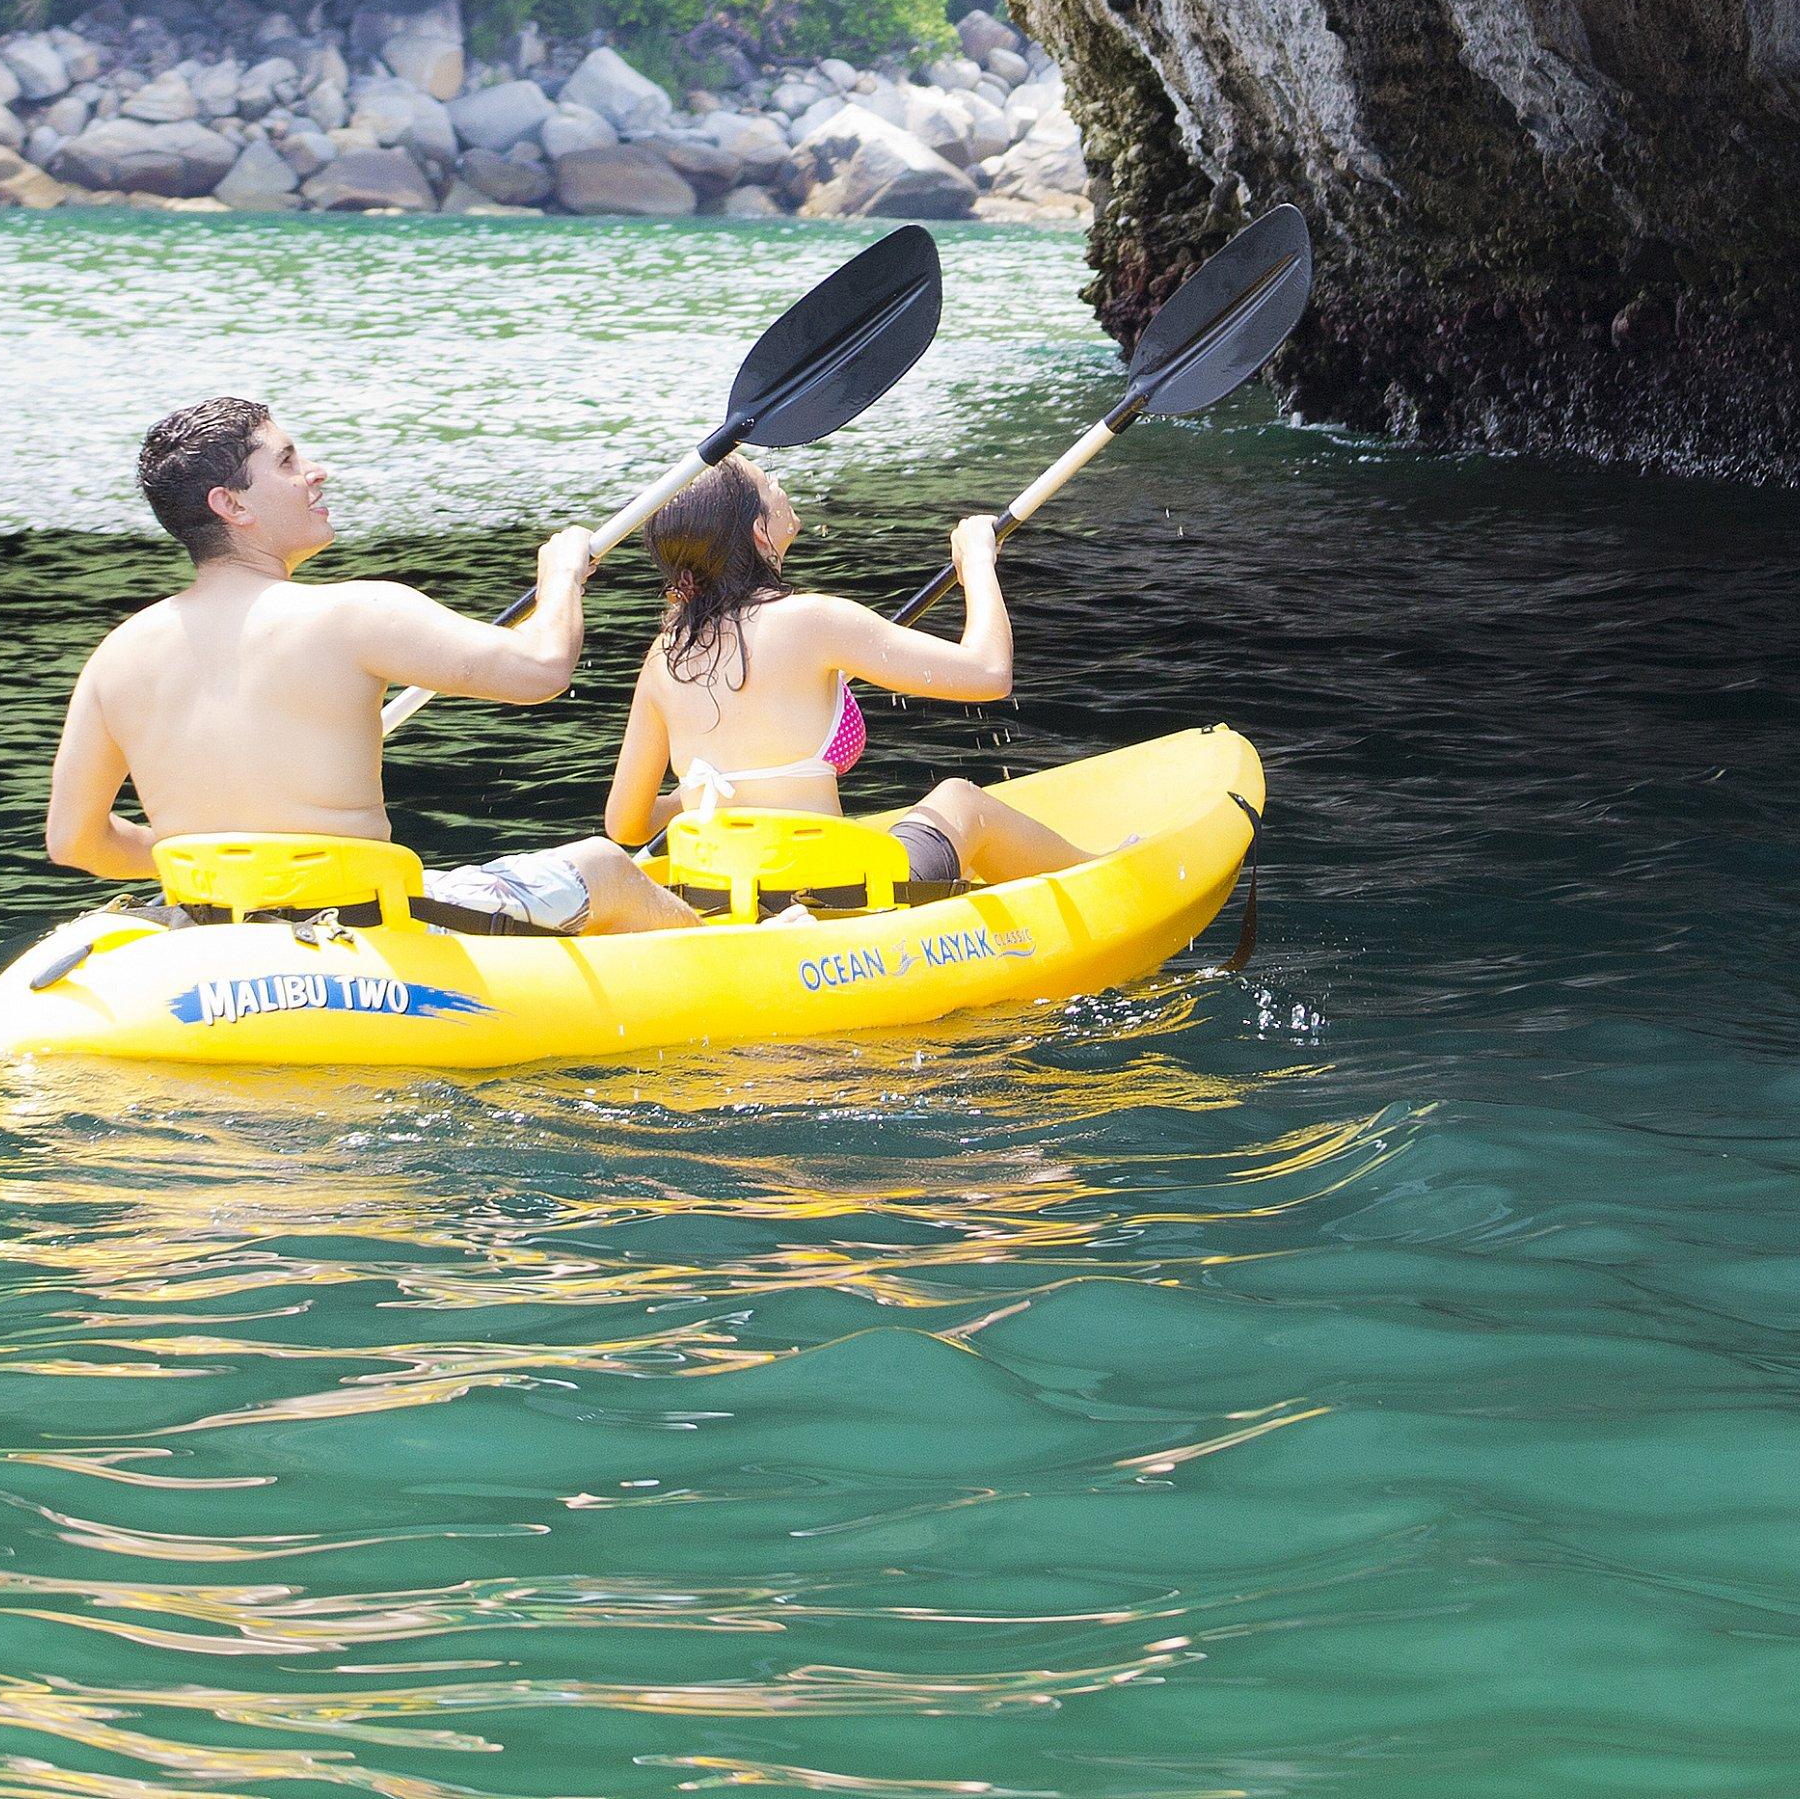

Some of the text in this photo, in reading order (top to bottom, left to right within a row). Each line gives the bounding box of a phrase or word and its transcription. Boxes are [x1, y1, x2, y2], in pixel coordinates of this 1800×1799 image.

[800, 928, 1033, 991] OCEAN KAYAK CLASSIC
[199, 975, 410, 1026] MALIBU TWO
